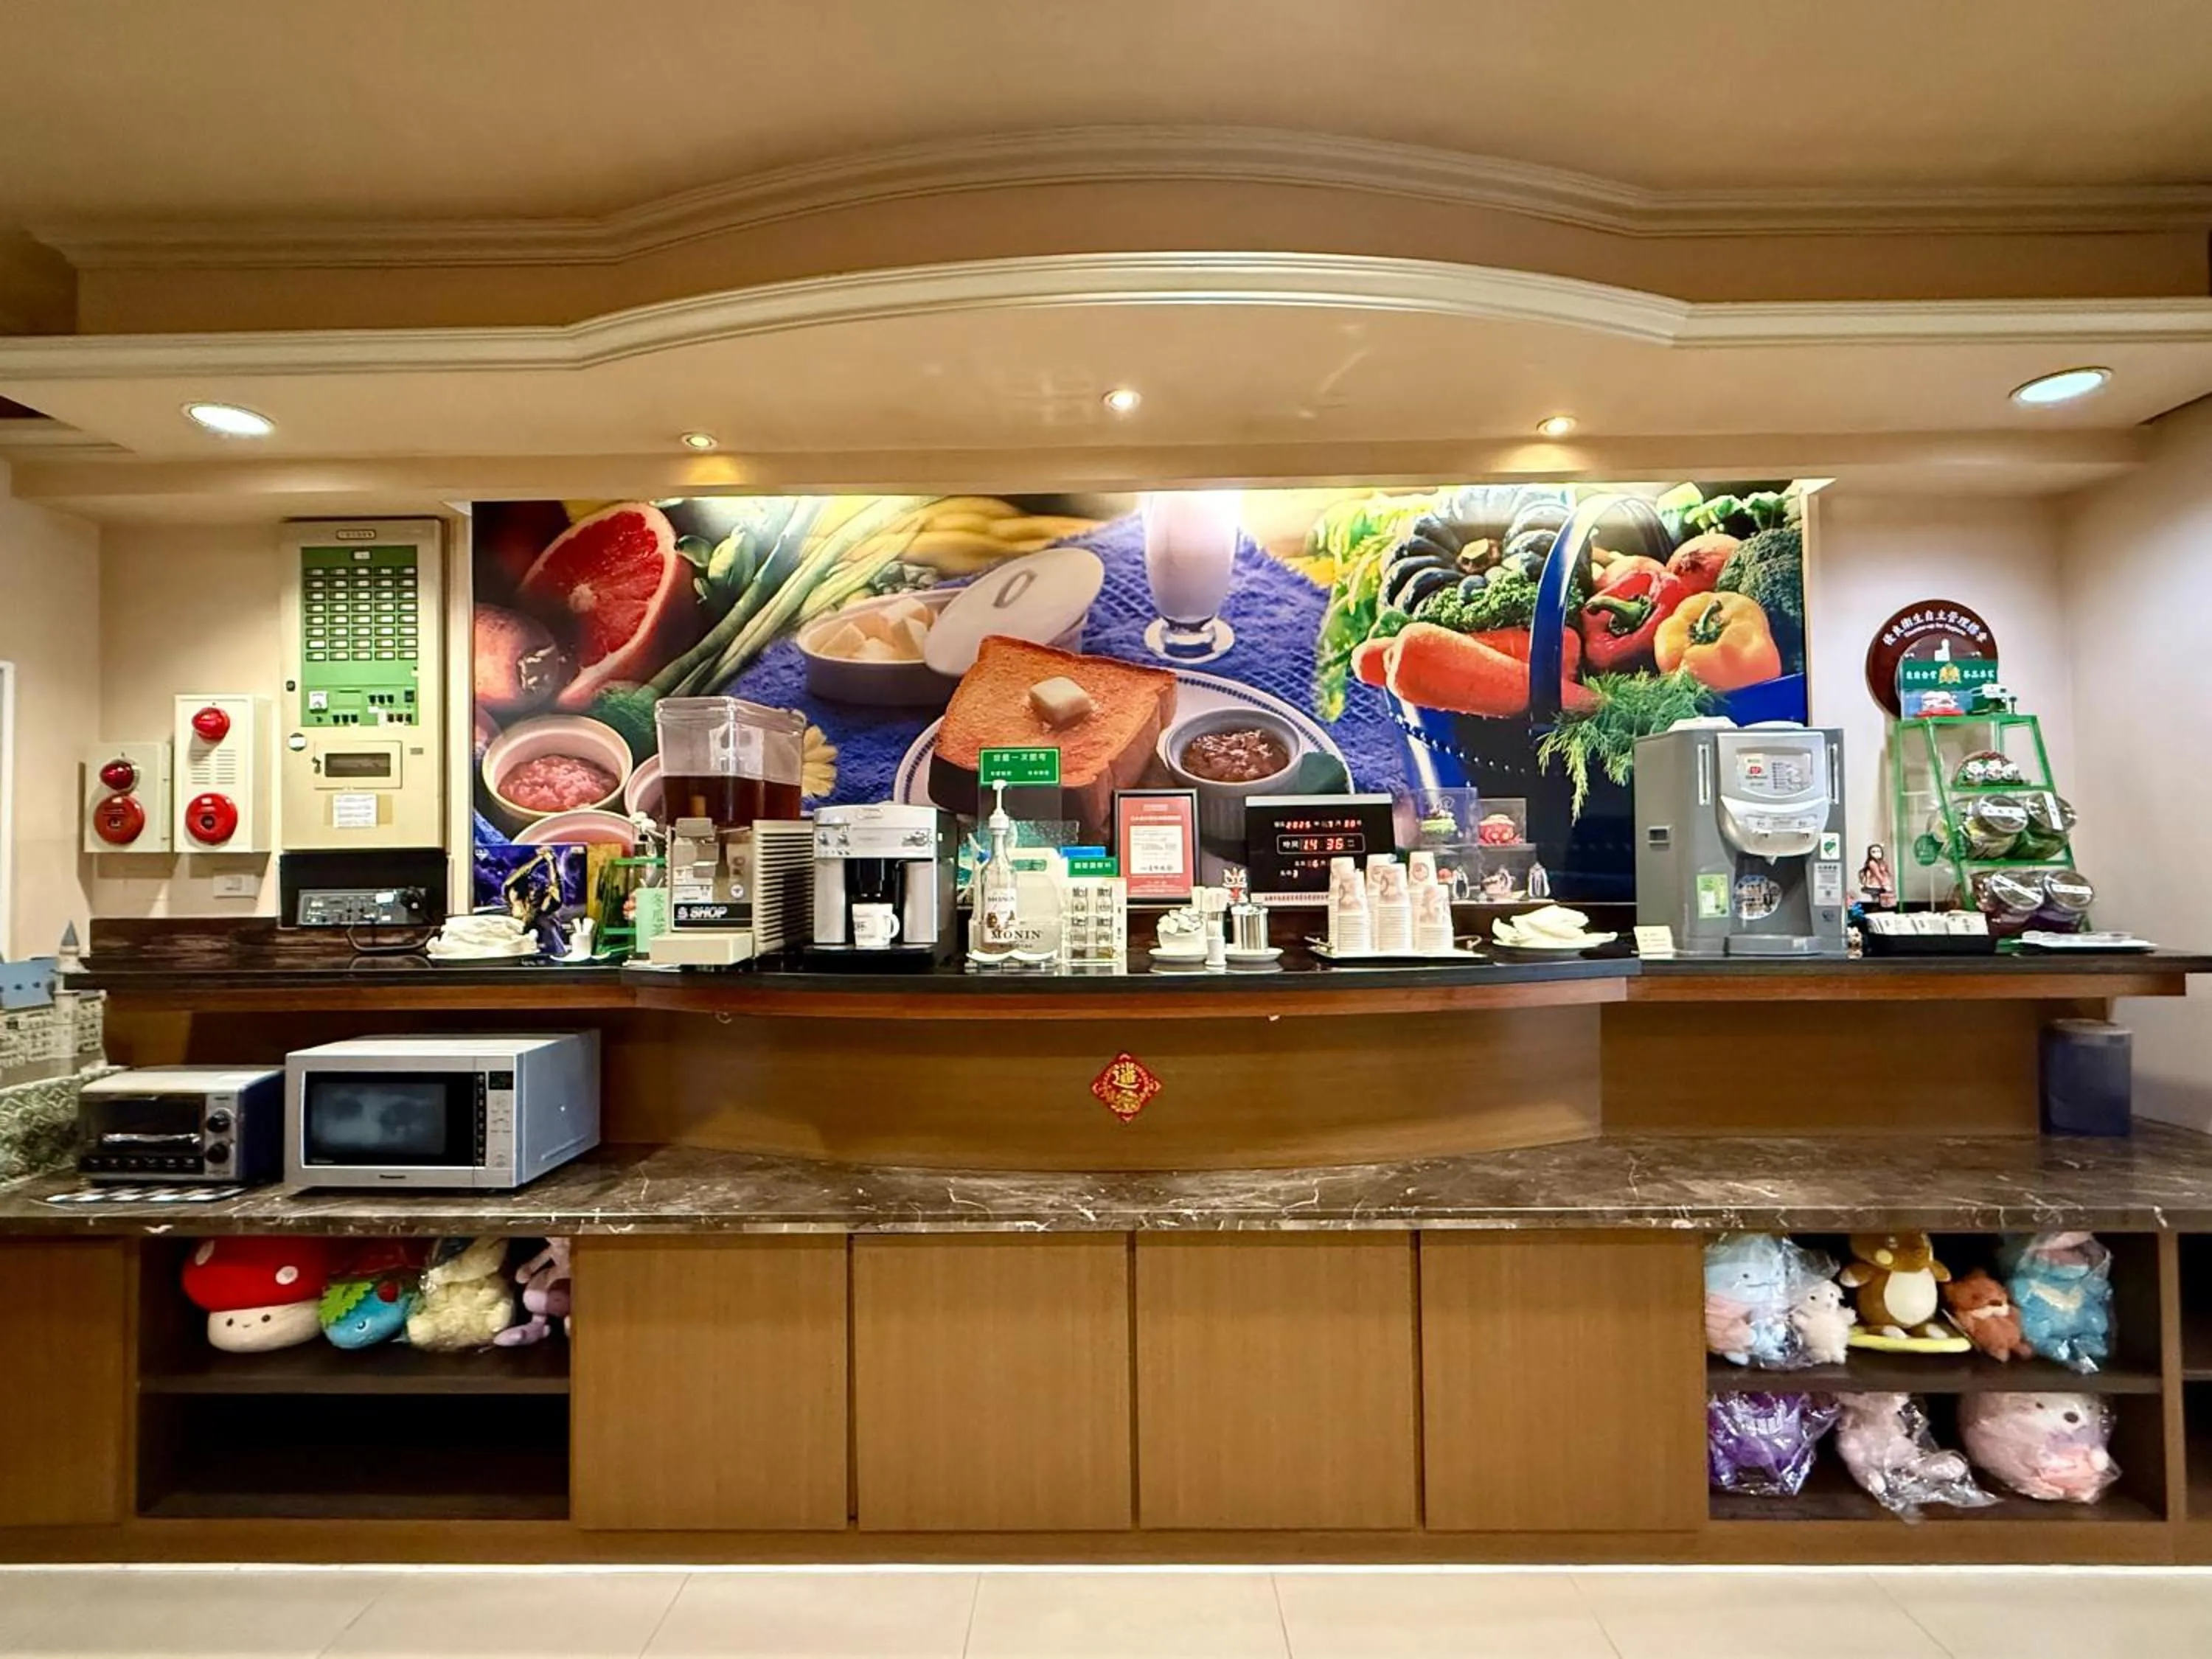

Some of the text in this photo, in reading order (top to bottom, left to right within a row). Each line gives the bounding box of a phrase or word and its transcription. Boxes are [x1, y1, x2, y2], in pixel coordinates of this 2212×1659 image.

[1304, 838, 1318, 850] 14
[1326, 837, 1343, 850] 36
[689, 905, 728, 919] SHOP
[991, 930, 1041, 939] MONIN
